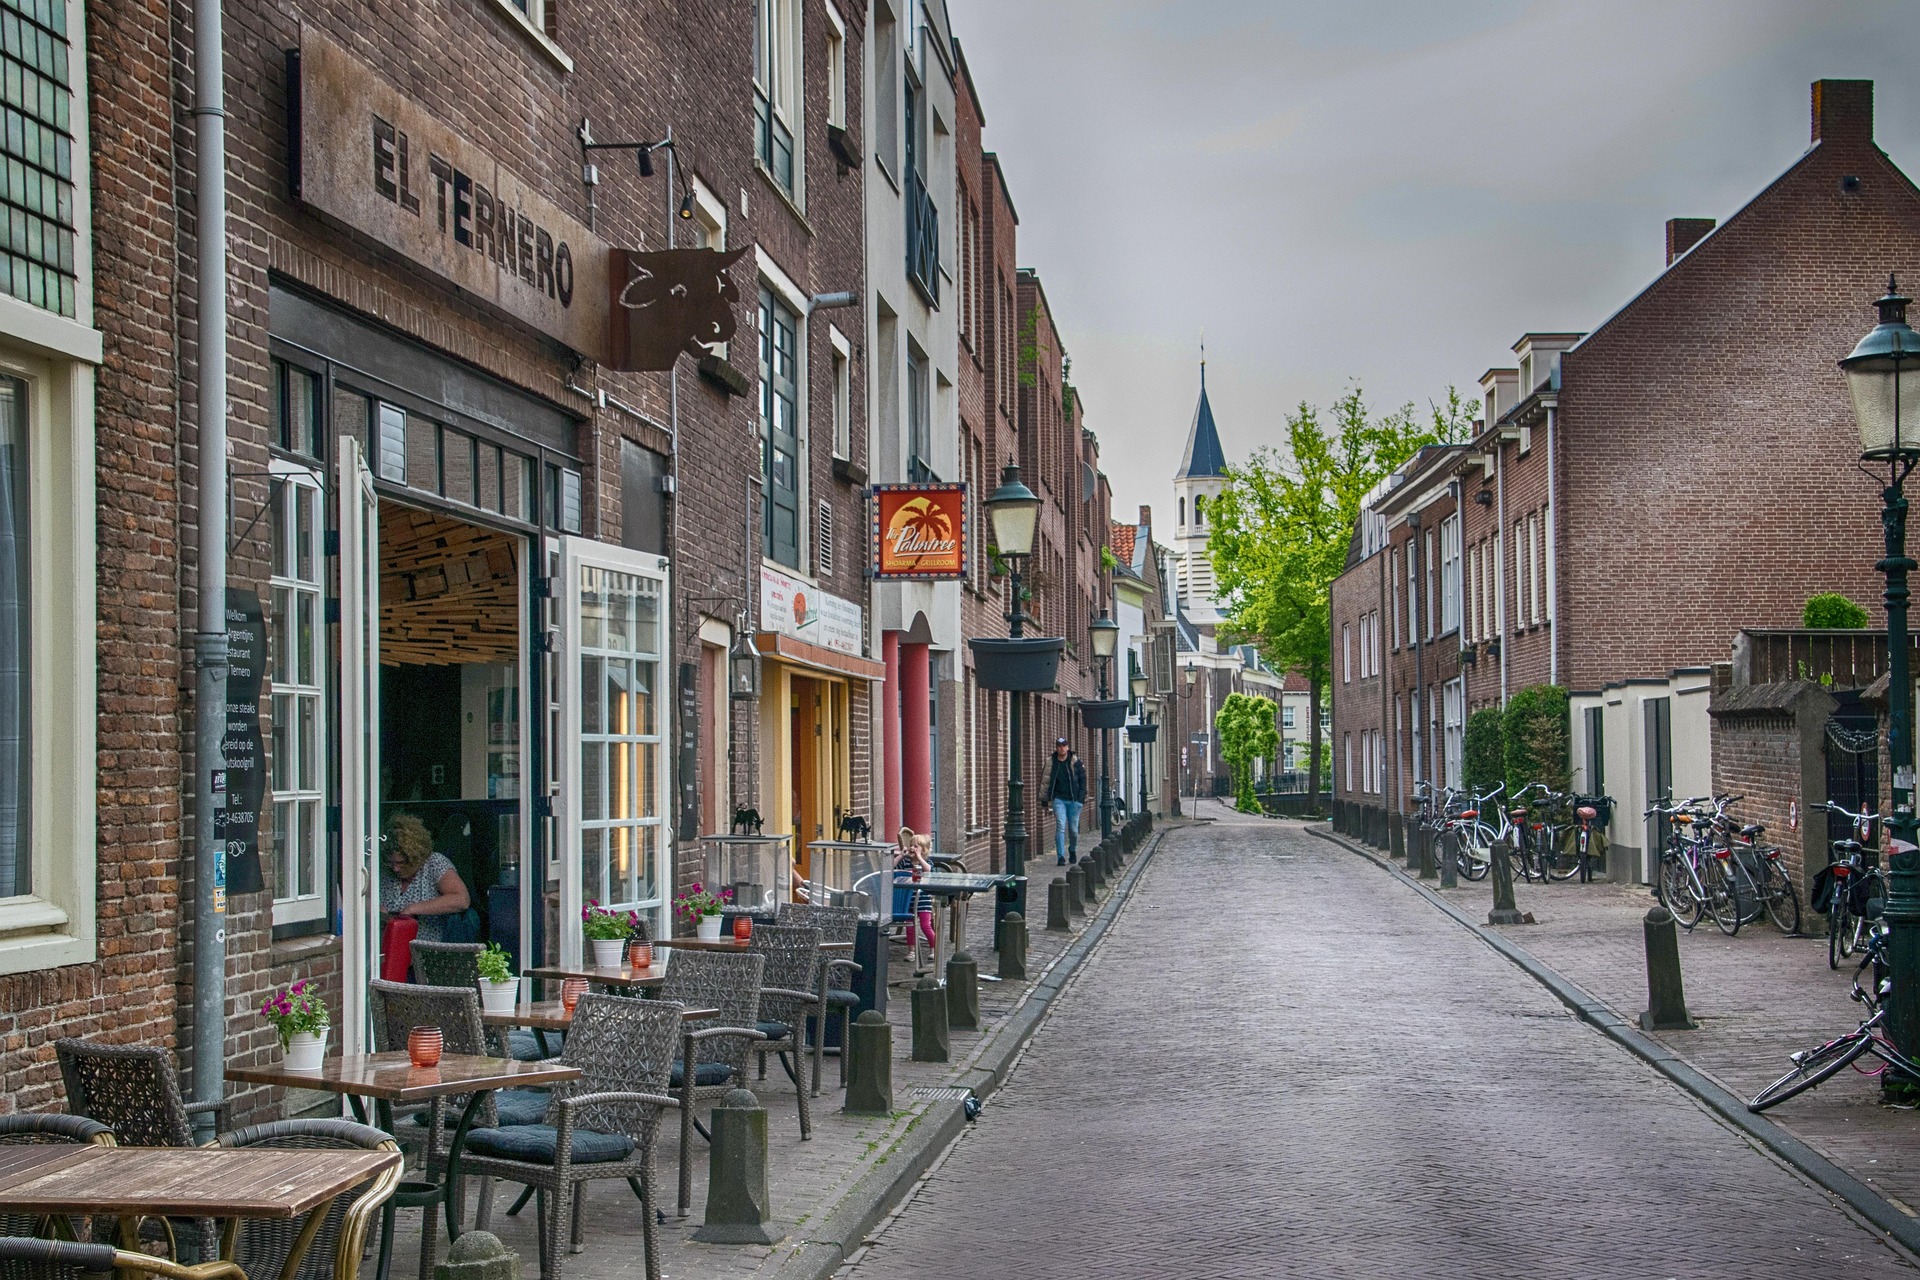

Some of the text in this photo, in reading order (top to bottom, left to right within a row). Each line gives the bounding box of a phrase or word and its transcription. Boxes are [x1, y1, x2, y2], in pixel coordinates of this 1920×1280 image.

[372, 113, 574, 309] EL TERNERO
[885, 526, 956, 554] The Palmtree
[885, 559, 956, 568] SHOARMA GRILLROOM
[225, 609, 248, 622] Welkom
[226, 648, 251, 659] estaurant
[230, 664, 251, 677] Ternero
[226, 702, 256, 714] onze steaks
[227, 719, 248, 732] worden
[225, 738, 254, 752] ereid op de
[226, 756, 255, 771] utskoolgrill
[226, 811, 254, 824] 3-4638705
